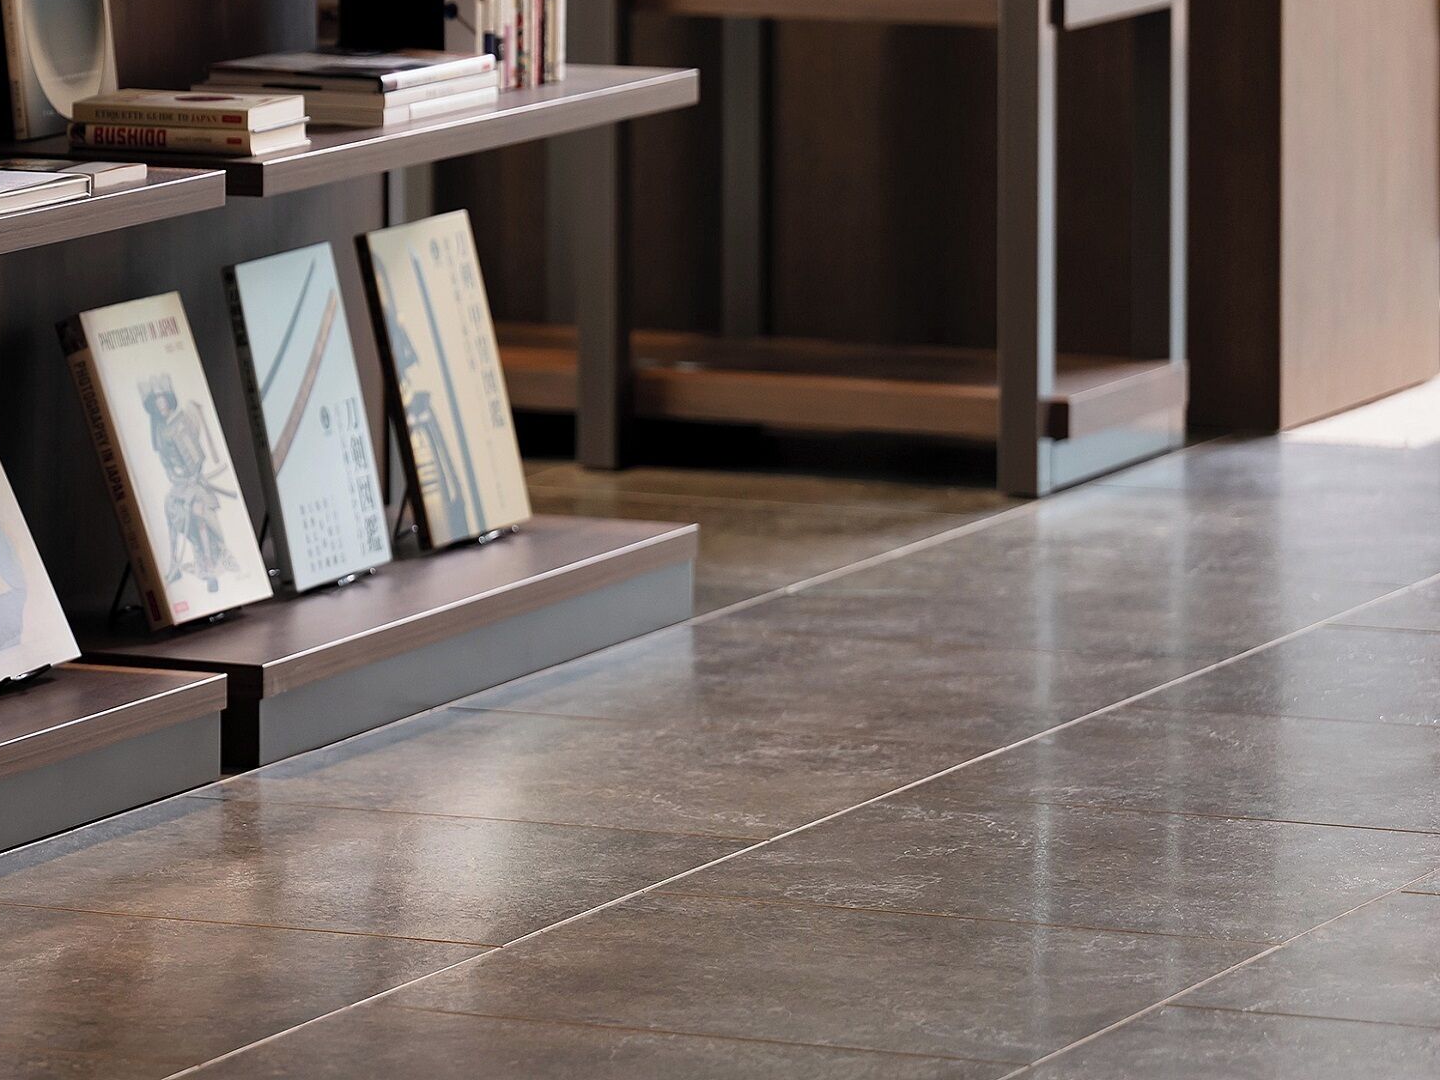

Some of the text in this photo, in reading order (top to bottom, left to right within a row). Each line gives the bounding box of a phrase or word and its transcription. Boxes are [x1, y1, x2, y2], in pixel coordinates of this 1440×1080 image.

[178, 111, 191, 121] TO
[191, 112, 218, 123] JAPAN
[93, 126, 167, 147] BUSHIDO
